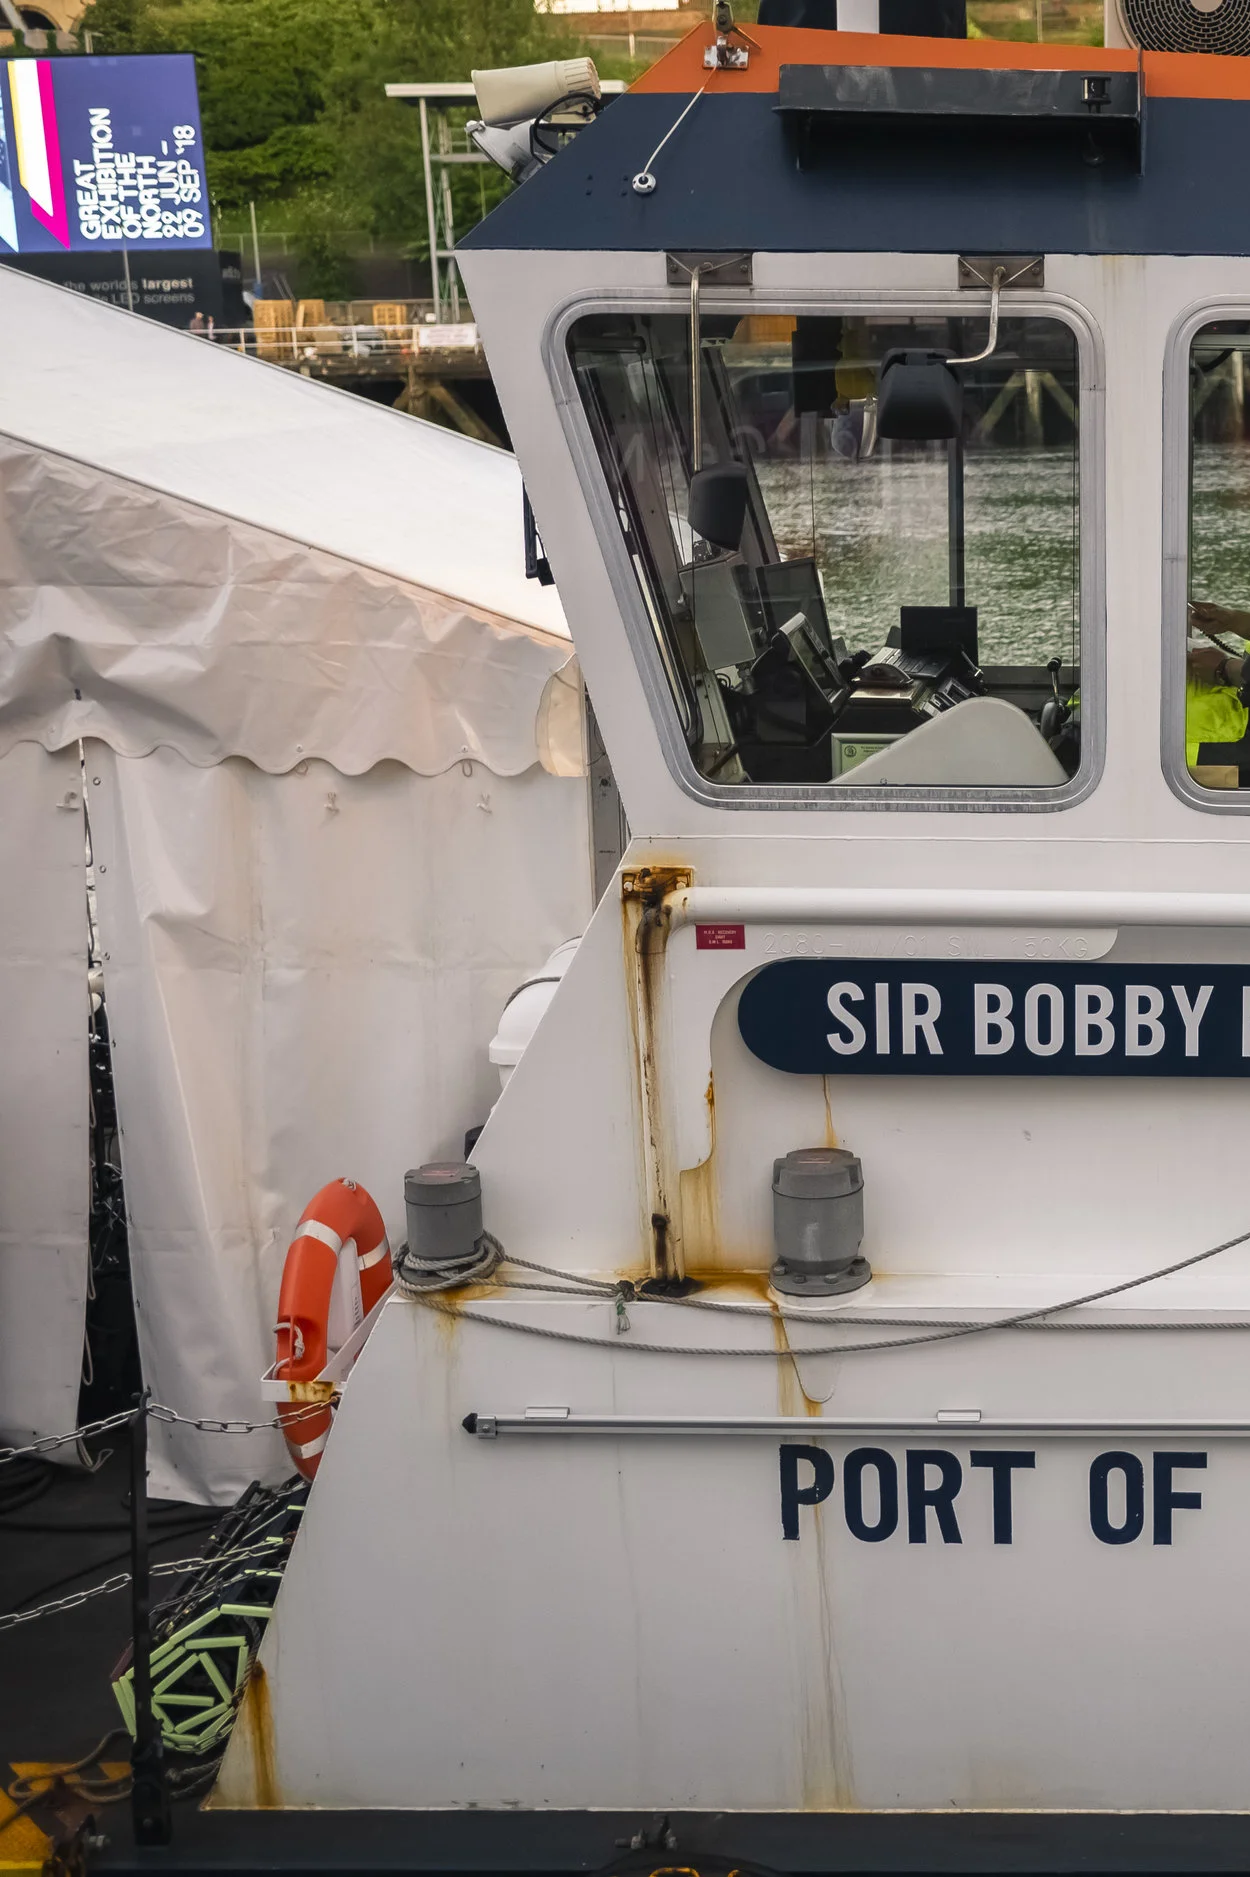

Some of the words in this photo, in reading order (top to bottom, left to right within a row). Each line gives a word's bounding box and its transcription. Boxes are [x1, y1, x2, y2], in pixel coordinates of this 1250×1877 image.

[88, 108, 123, 240] EXHIBITION
[114, 152, 139, 202] THE
[156, 161, 181, 205] JUN
[177, 159, 201, 203] SEP
[73, 159, 101, 240] GREAT
[135, 156, 163, 239] NORTH
[119, 205, 143, 239] OF
[160, 211, 184, 238] 22
[181, 208, 205, 238] 09
[142, 278, 193, 292] largest
[144, 293, 195, 305] screens
[826, 981, 944, 1056] SIR
[975, 984, 1214, 1057] BOBBY
[780, 1443, 1036, 1546] PORT
[1090, 1450, 1208, 1546] OF
